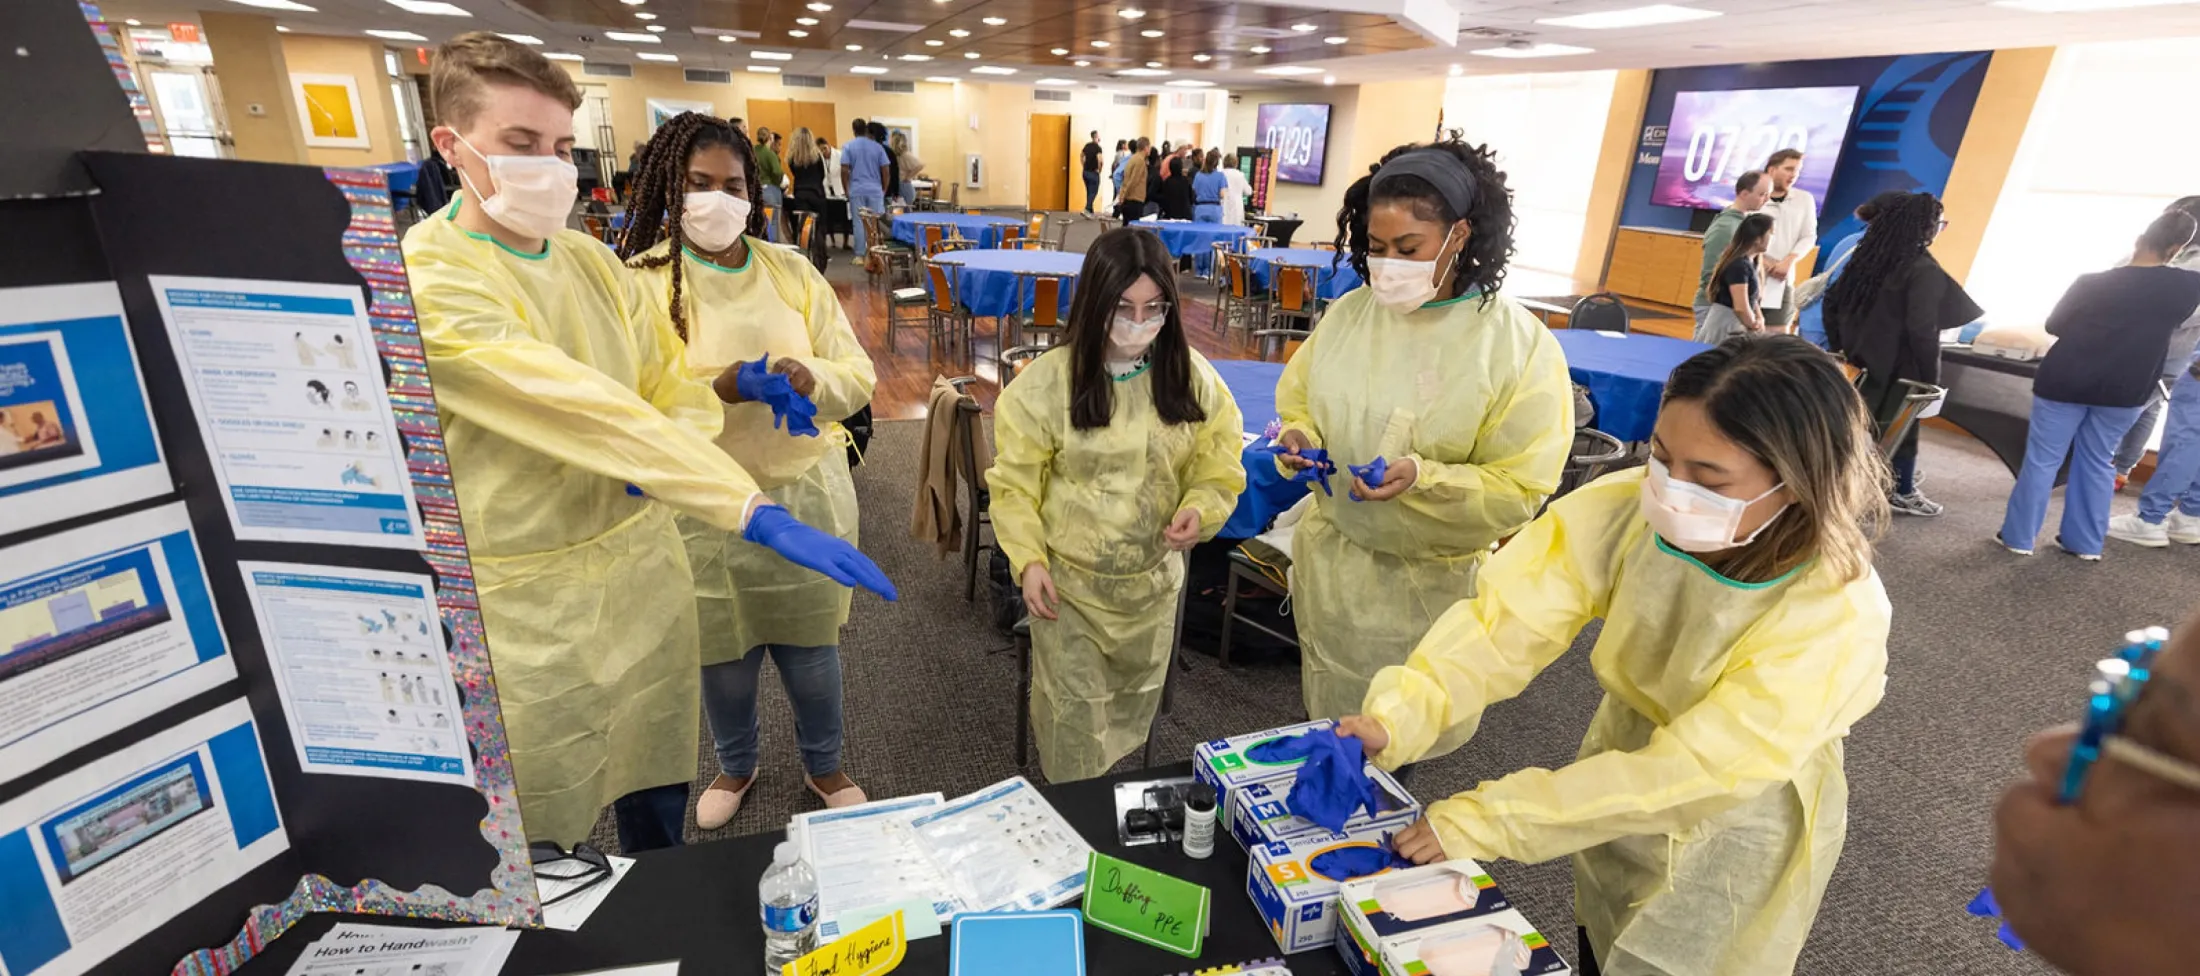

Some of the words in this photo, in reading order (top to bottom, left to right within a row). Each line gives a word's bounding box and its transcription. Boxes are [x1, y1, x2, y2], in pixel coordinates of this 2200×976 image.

[1220, 756, 1236, 768] L
[1257, 804, 1281, 818] M
[1278, 863, 1297, 880] S
[1154, 911, 1184, 936] PPE
[314, 946, 355, 958] How
[357, 943, 375, 954] to
[379, 934, 479, 952] Handwash?
[804, 953, 840, 976] Hand
[844, 935, 891, 969] Hygiene
